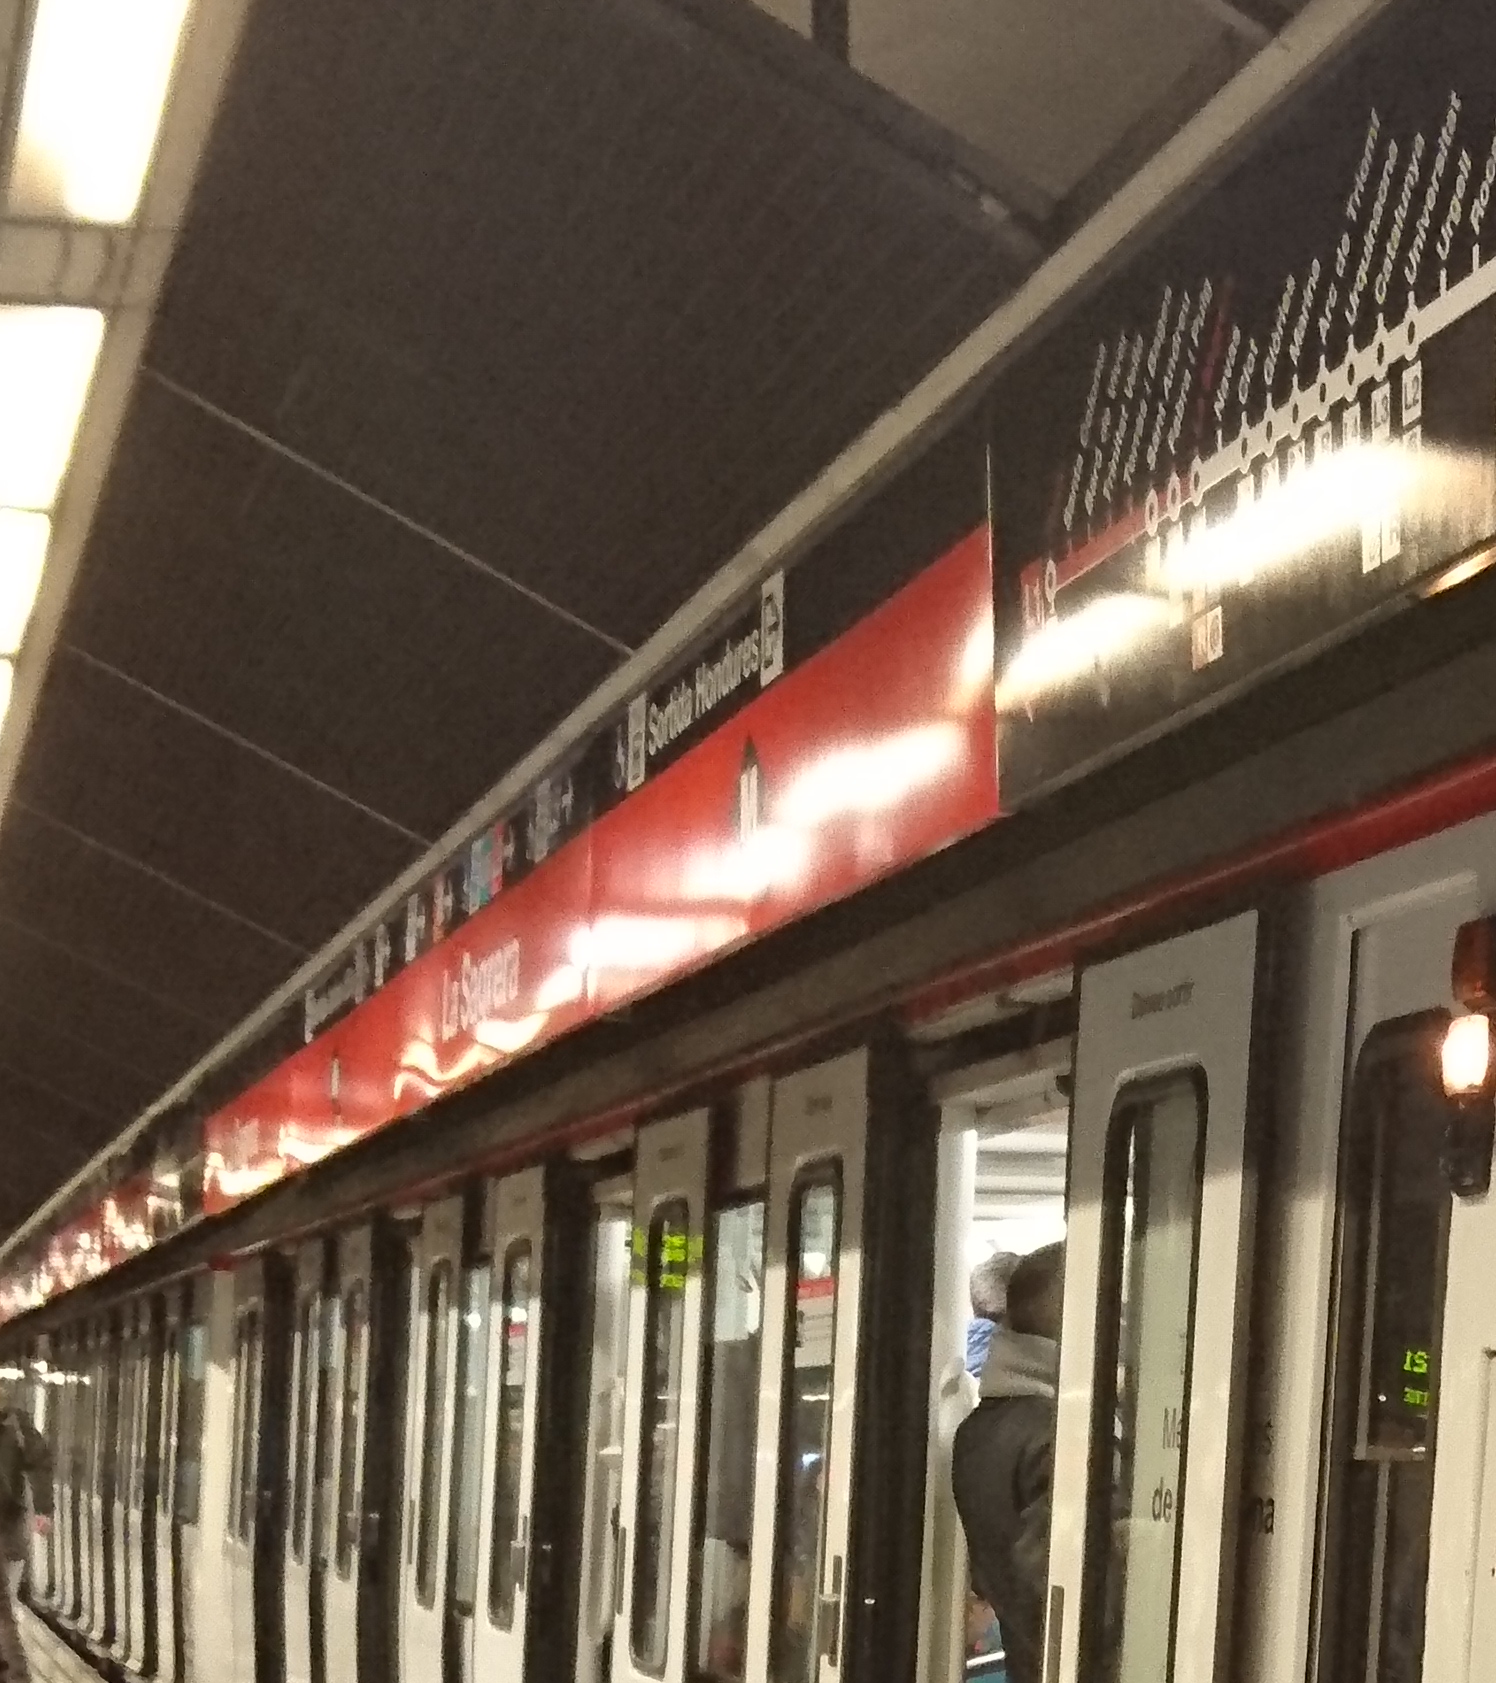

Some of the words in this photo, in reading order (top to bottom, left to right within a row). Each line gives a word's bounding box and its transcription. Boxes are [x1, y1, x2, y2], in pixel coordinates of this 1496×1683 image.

[1345, 138, 1398, 326] Urquinaona
[1375, 132, 1425, 305] Catalunya
[1405, 89, 1462, 286] Universitat
[1436, 148, 1472, 261] Urgell
[1290, 258, 1321, 366] Marina
[1319, 282, 1338, 346] Arc
[1213, 323, 1241, 421] Navas
[1239, 337, 1258, 404] Clot
[1405, 373, 1421, 416] L2
[695, 629, 759, 719] Hondures
[440, 967, 459, 1042] La
